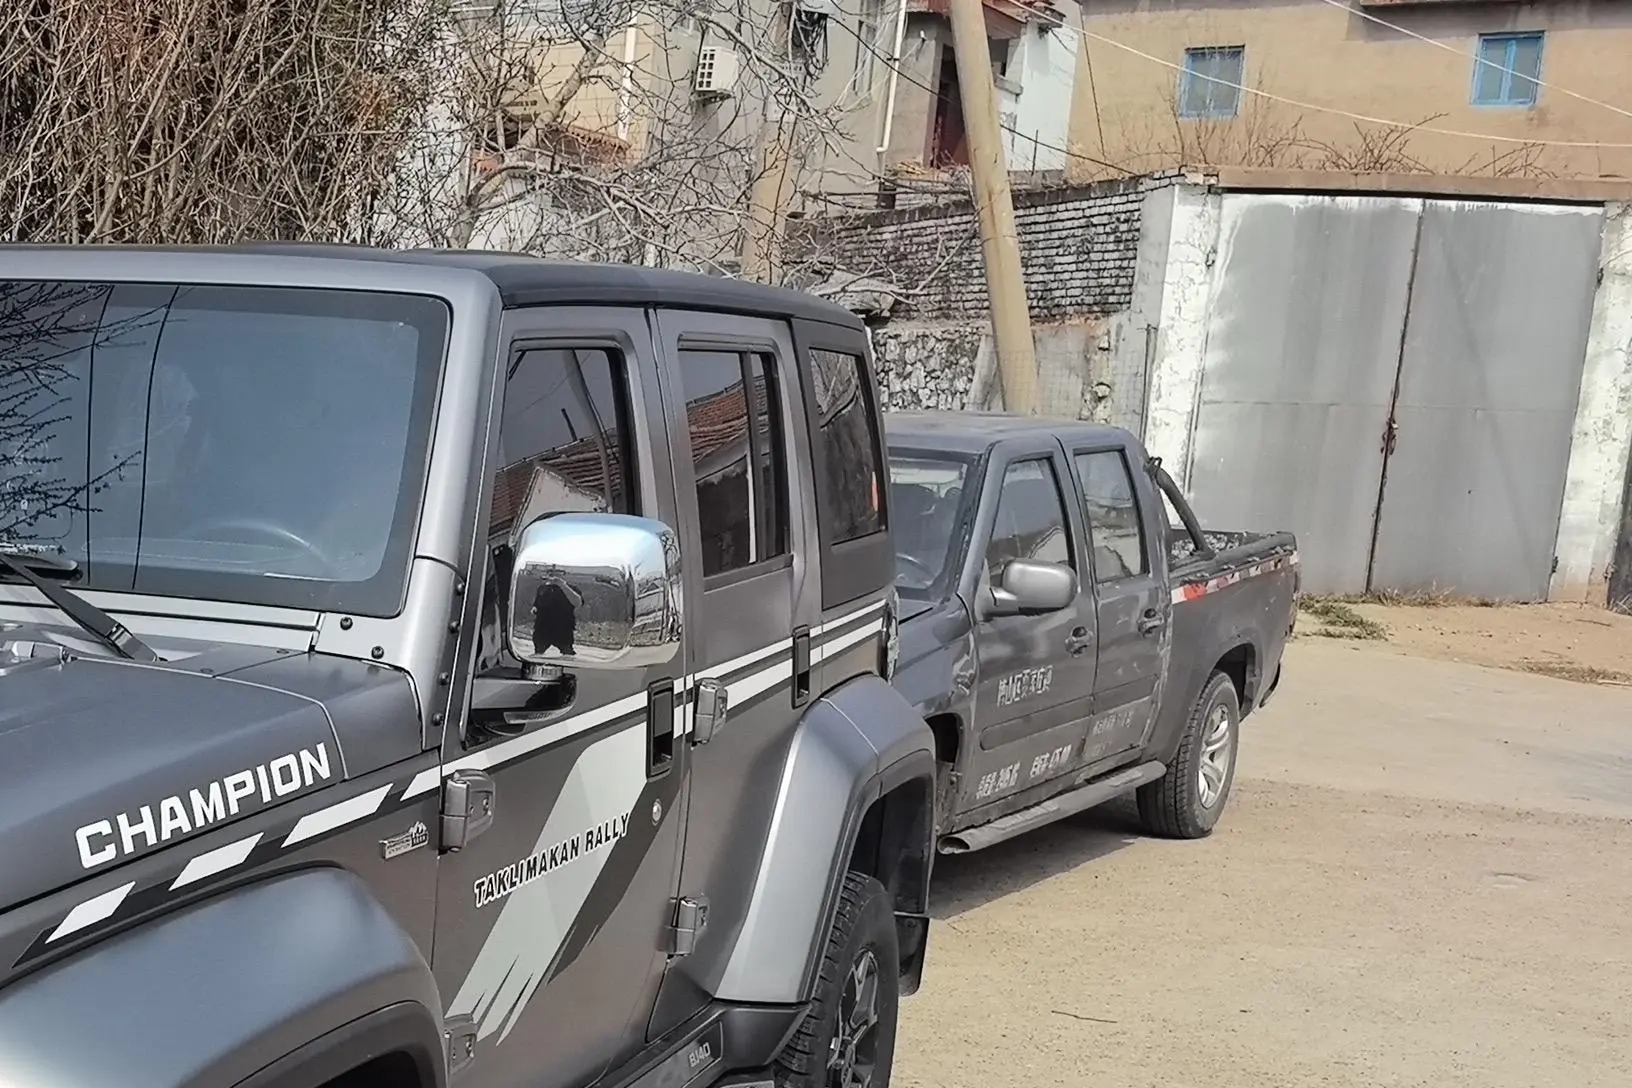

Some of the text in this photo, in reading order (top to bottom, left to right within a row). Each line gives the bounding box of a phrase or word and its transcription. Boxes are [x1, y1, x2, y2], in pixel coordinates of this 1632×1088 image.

[75, 742, 332, 869] CHAMPION
[473, 838, 580, 909] TAKLIMAKAN
[583, 811, 632, 854] RALLY
[688, 1041, 711, 1068] BJ40
